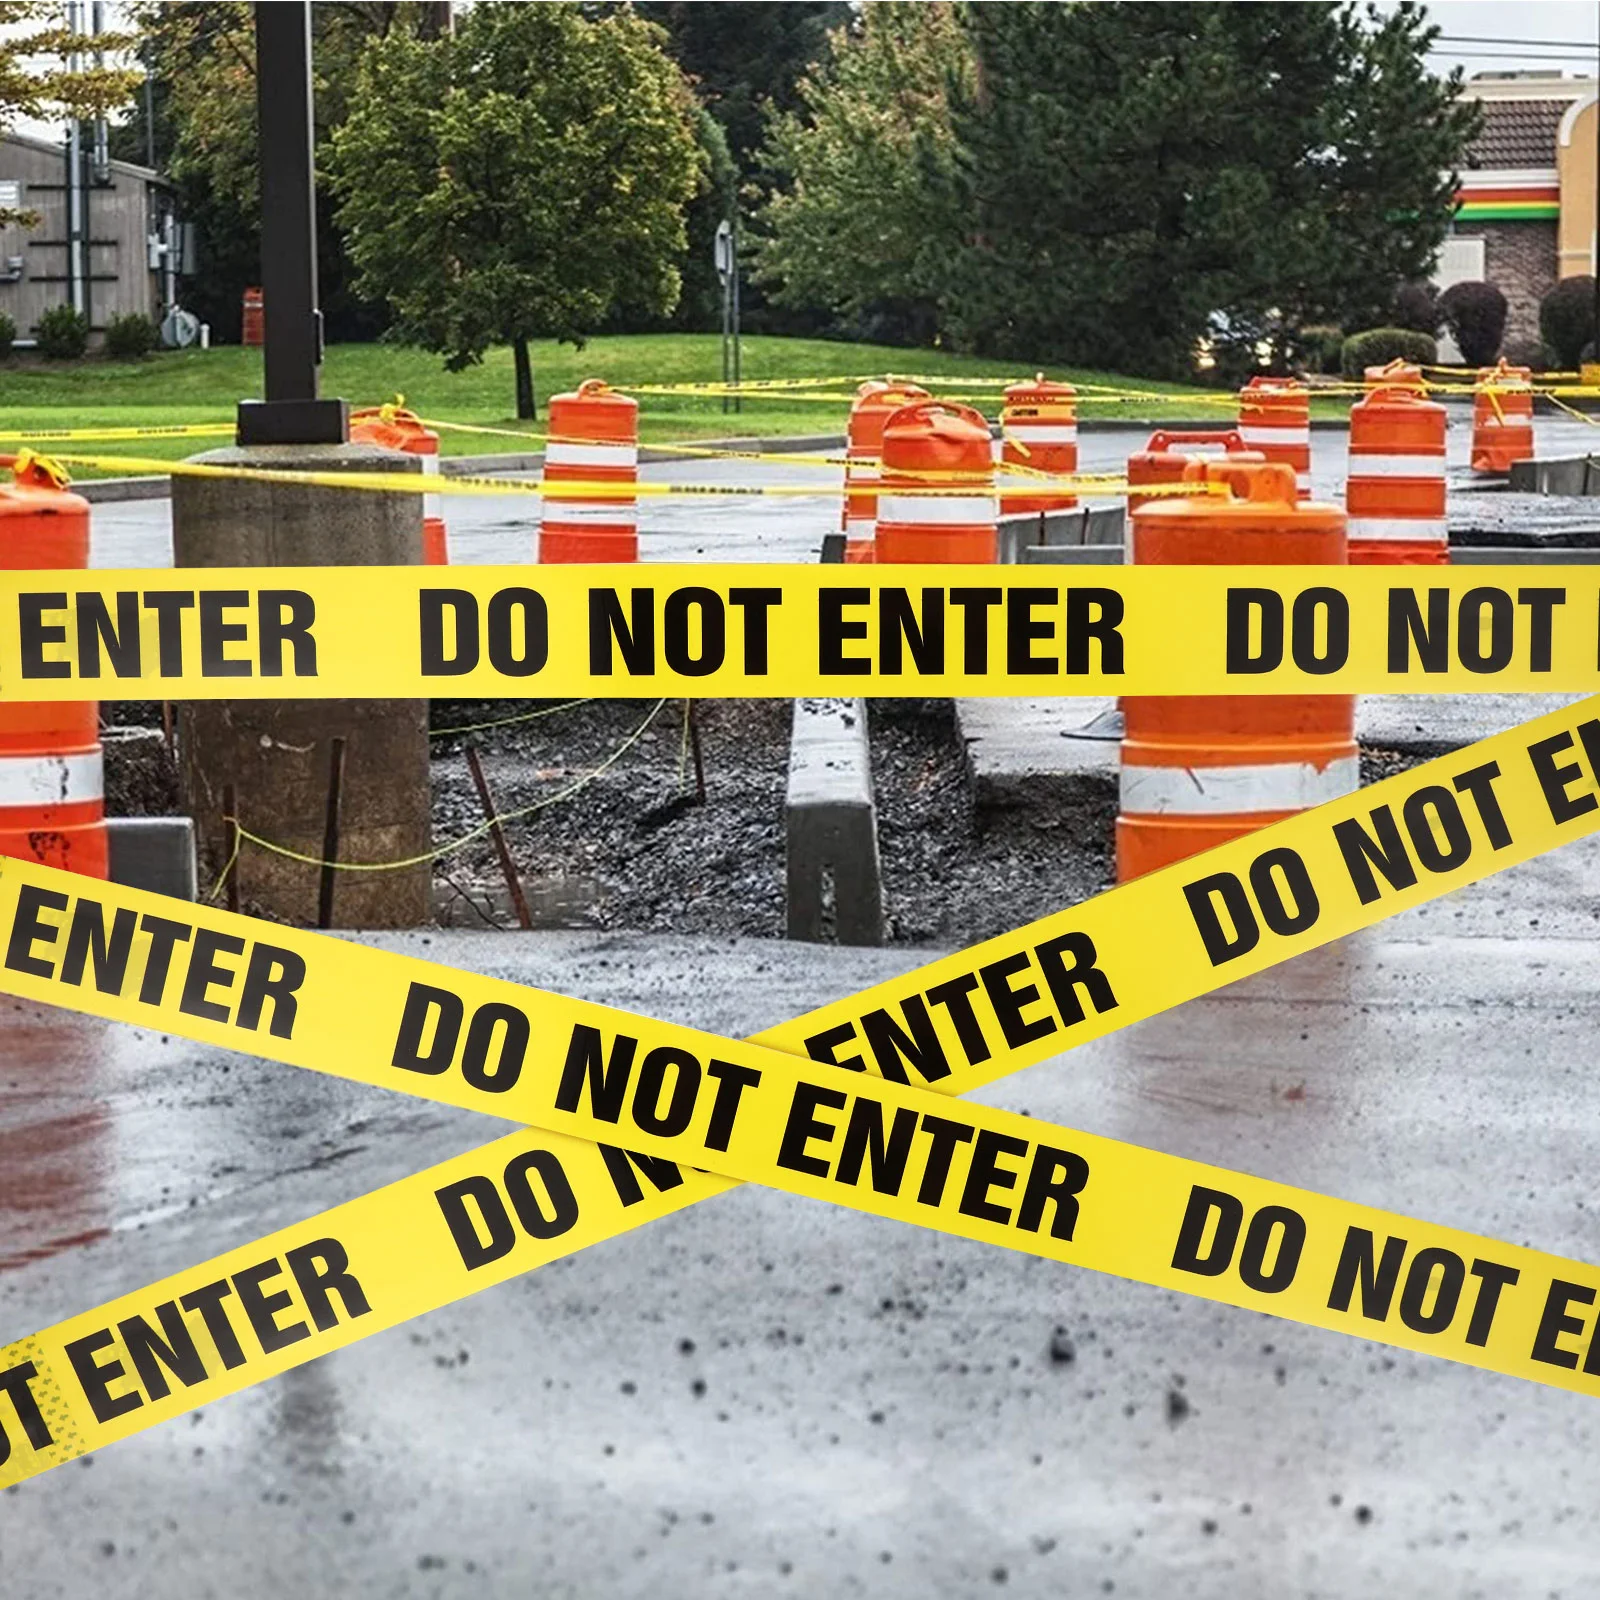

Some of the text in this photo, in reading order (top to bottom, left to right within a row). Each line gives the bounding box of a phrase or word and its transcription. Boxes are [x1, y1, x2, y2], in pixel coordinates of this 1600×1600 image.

[19, 590, 317, 679] ENTER
[420, 587, 548, 676] DO
[589, 586, 782, 676] NOT
[819, 587, 1124, 675] ENTER
[1227, 586, 1349, 674] DO
[1388, 586, 1566, 674] NOT
[0, 1360, 54, 1466] T
[64, 1237, 371, 1424] ENTER
[435, 1150, 578, 1271] DO
[1183, 848, 1320, 966] DO
[1332, 760, 1513, 906] NOT
[5, 885, 305, 1040] ENTER
[392, 982, 531, 1093] DO
[555, 1023, 762, 1152] NOT
[777, 1081, 1090, 1241] ENTER
[1171, 1185, 1307, 1294] DO
[1327, 1226, 1521, 1347] NOT
